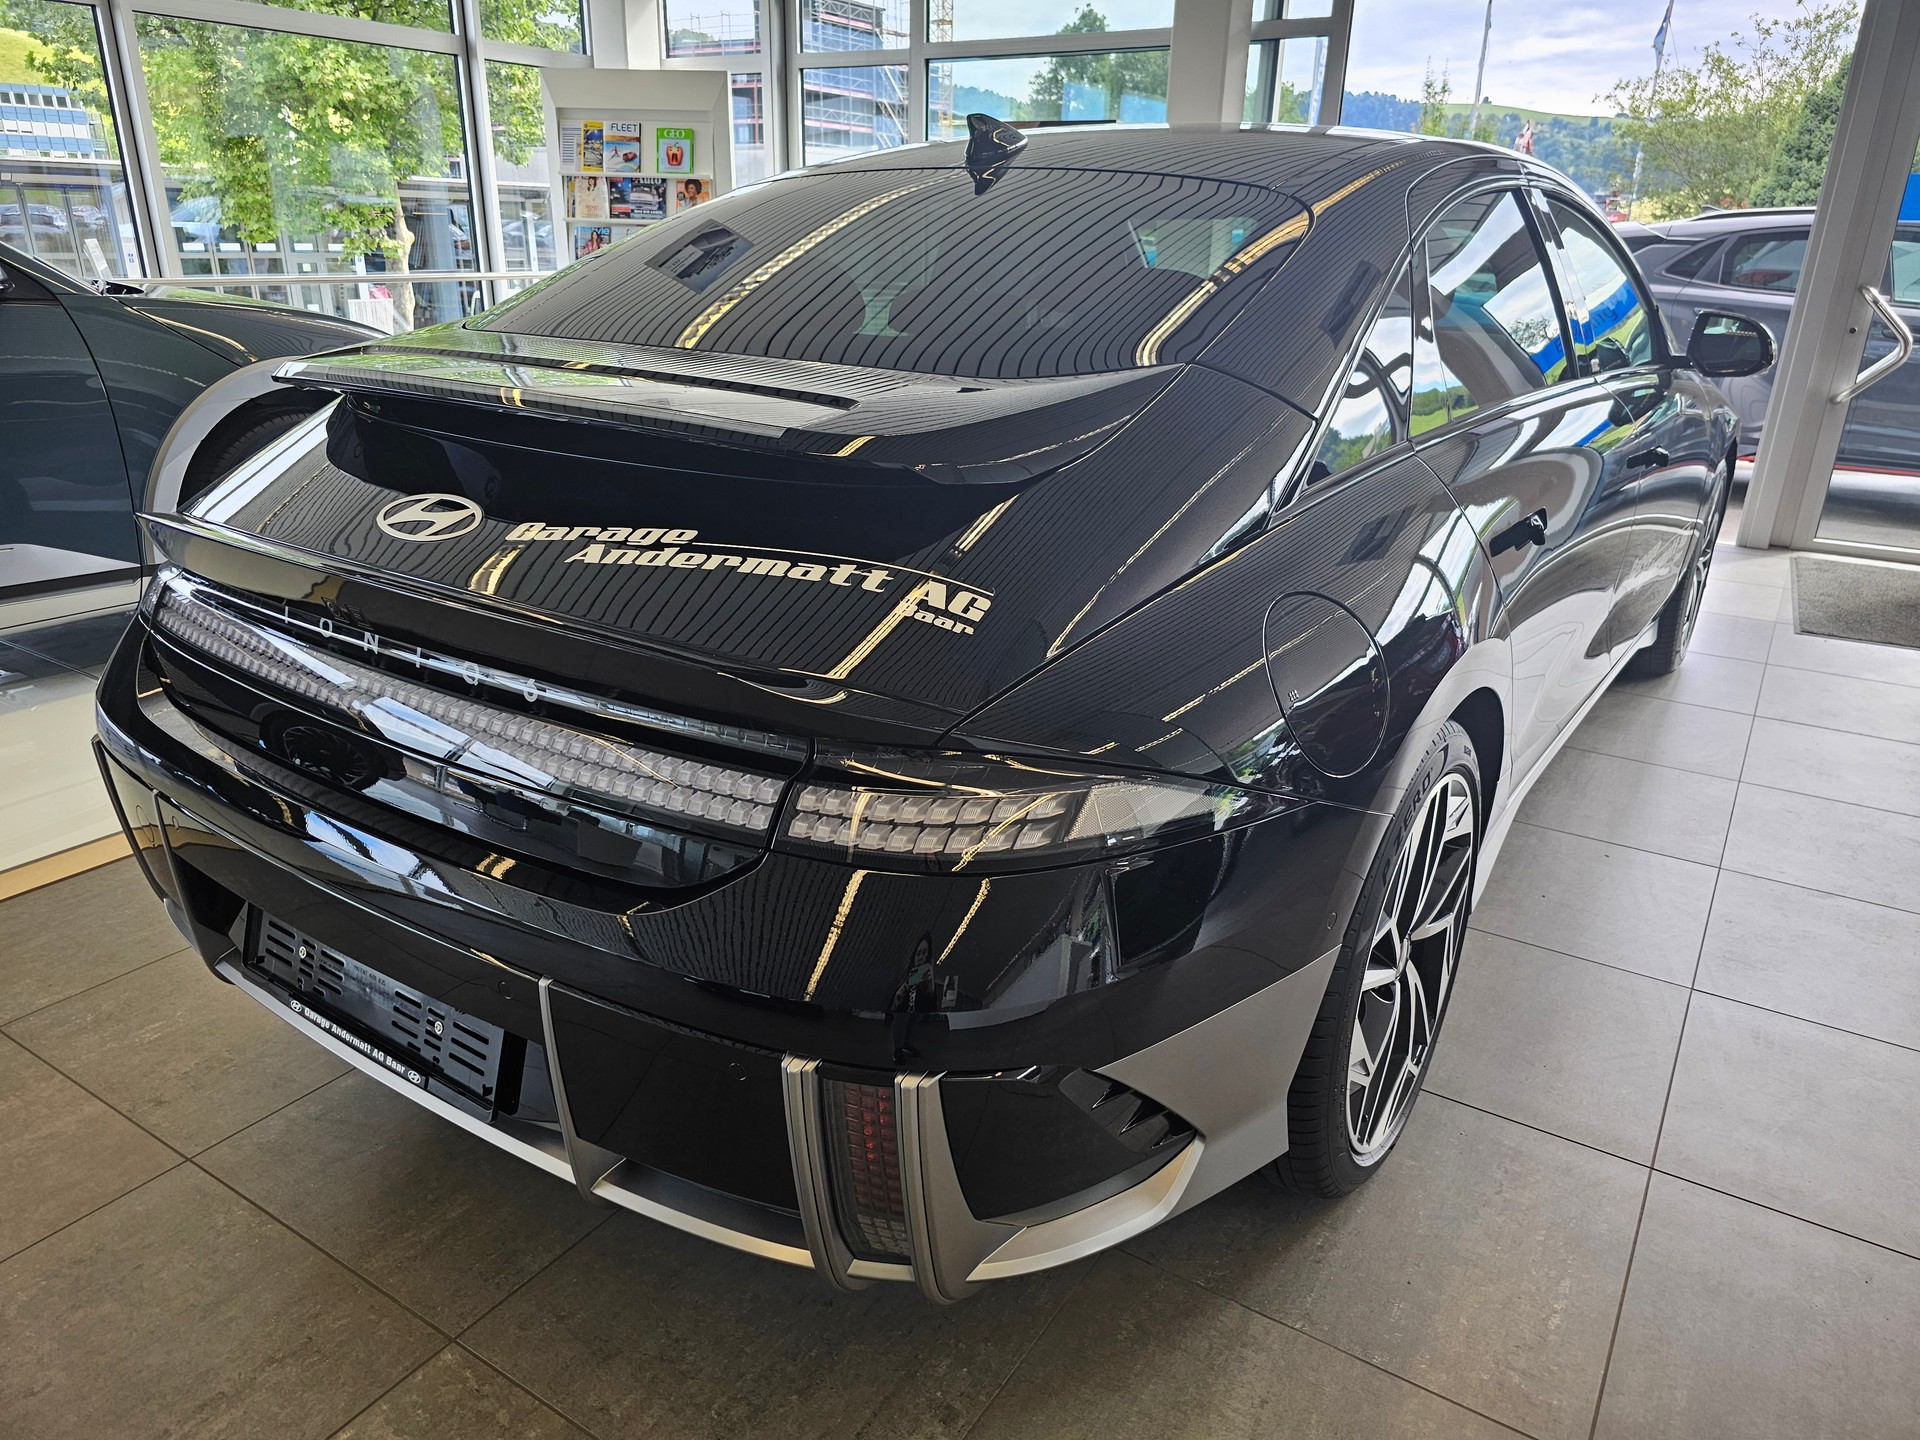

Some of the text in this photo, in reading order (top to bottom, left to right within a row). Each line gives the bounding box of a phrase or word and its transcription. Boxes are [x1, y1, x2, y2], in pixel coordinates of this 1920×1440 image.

[611, 122, 638, 132] FLEET
[663, 128, 685, 139] GEO
[505, 522, 699, 546] Garage
[564, 543, 992, 623] Andermatt AG
[899, 599, 975, 635] Baar
[523, 678, 539, 702] 6
[1393, 770, 1431, 857] ZERO
[304, 1007, 406, 1074] Garage Andermatt AG Baar
